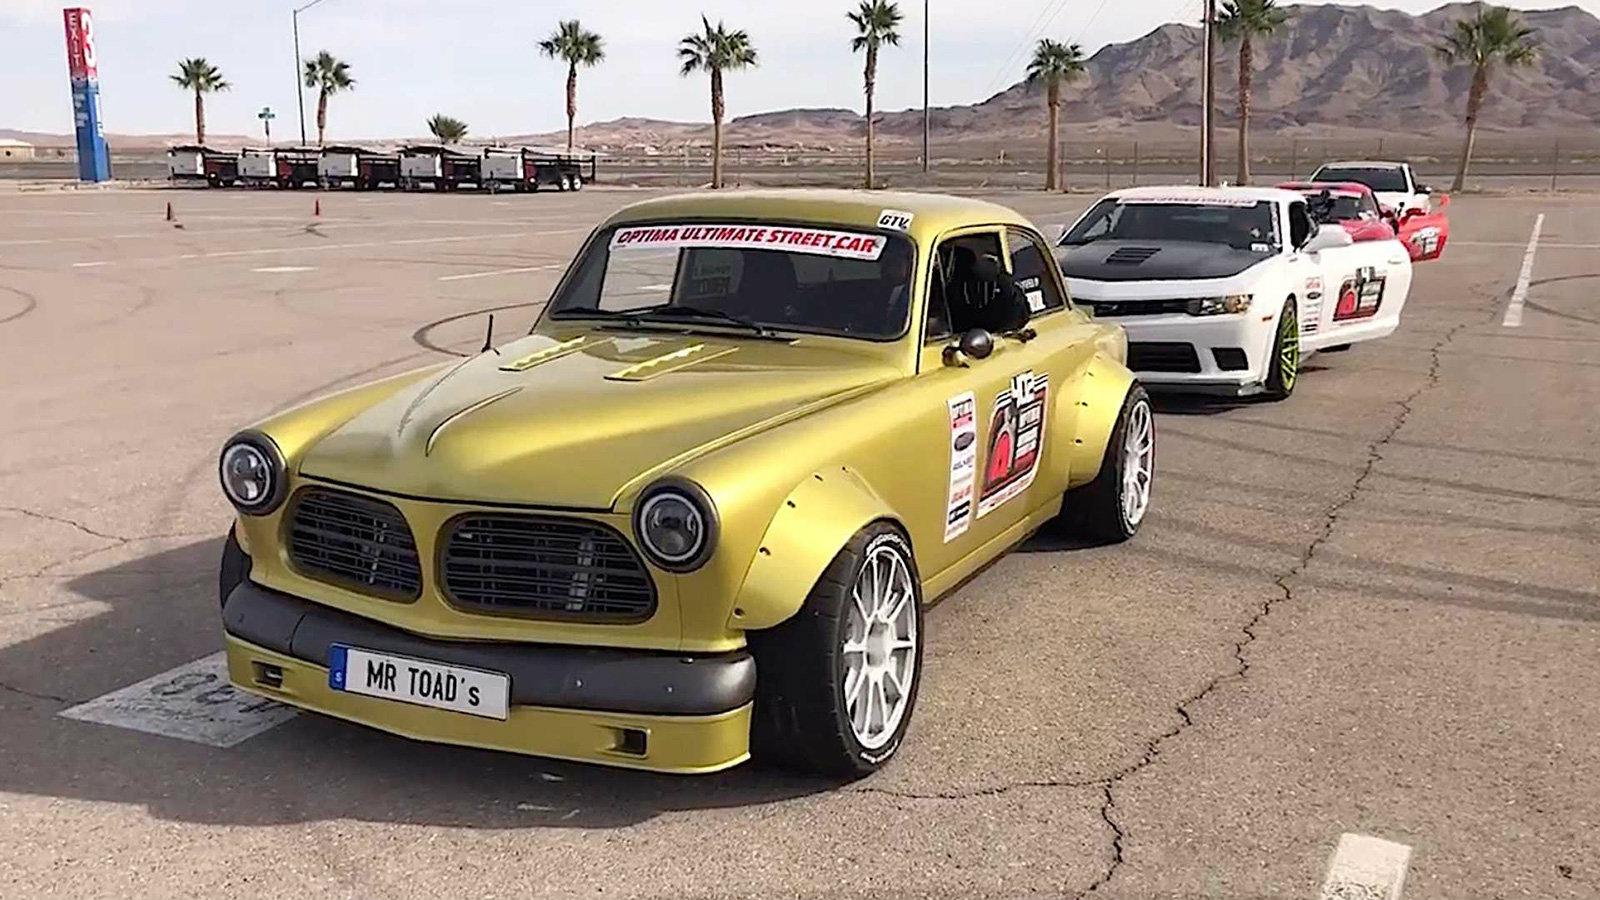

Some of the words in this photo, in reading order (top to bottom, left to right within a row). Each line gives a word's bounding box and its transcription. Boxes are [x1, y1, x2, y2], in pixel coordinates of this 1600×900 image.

[69, 12, 80, 68] EXIT
[81, 11, 97, 68] 3
[617, 228, 680, 243] OPTIMA
[680, 227, 767, 243] ULTIMATE
[767, 229, 836, 248] STREET
[832, 235, 877, 253] CAR
[366, 659, 397, 692] MR
[408, 667, 480, 706] TOAD's
